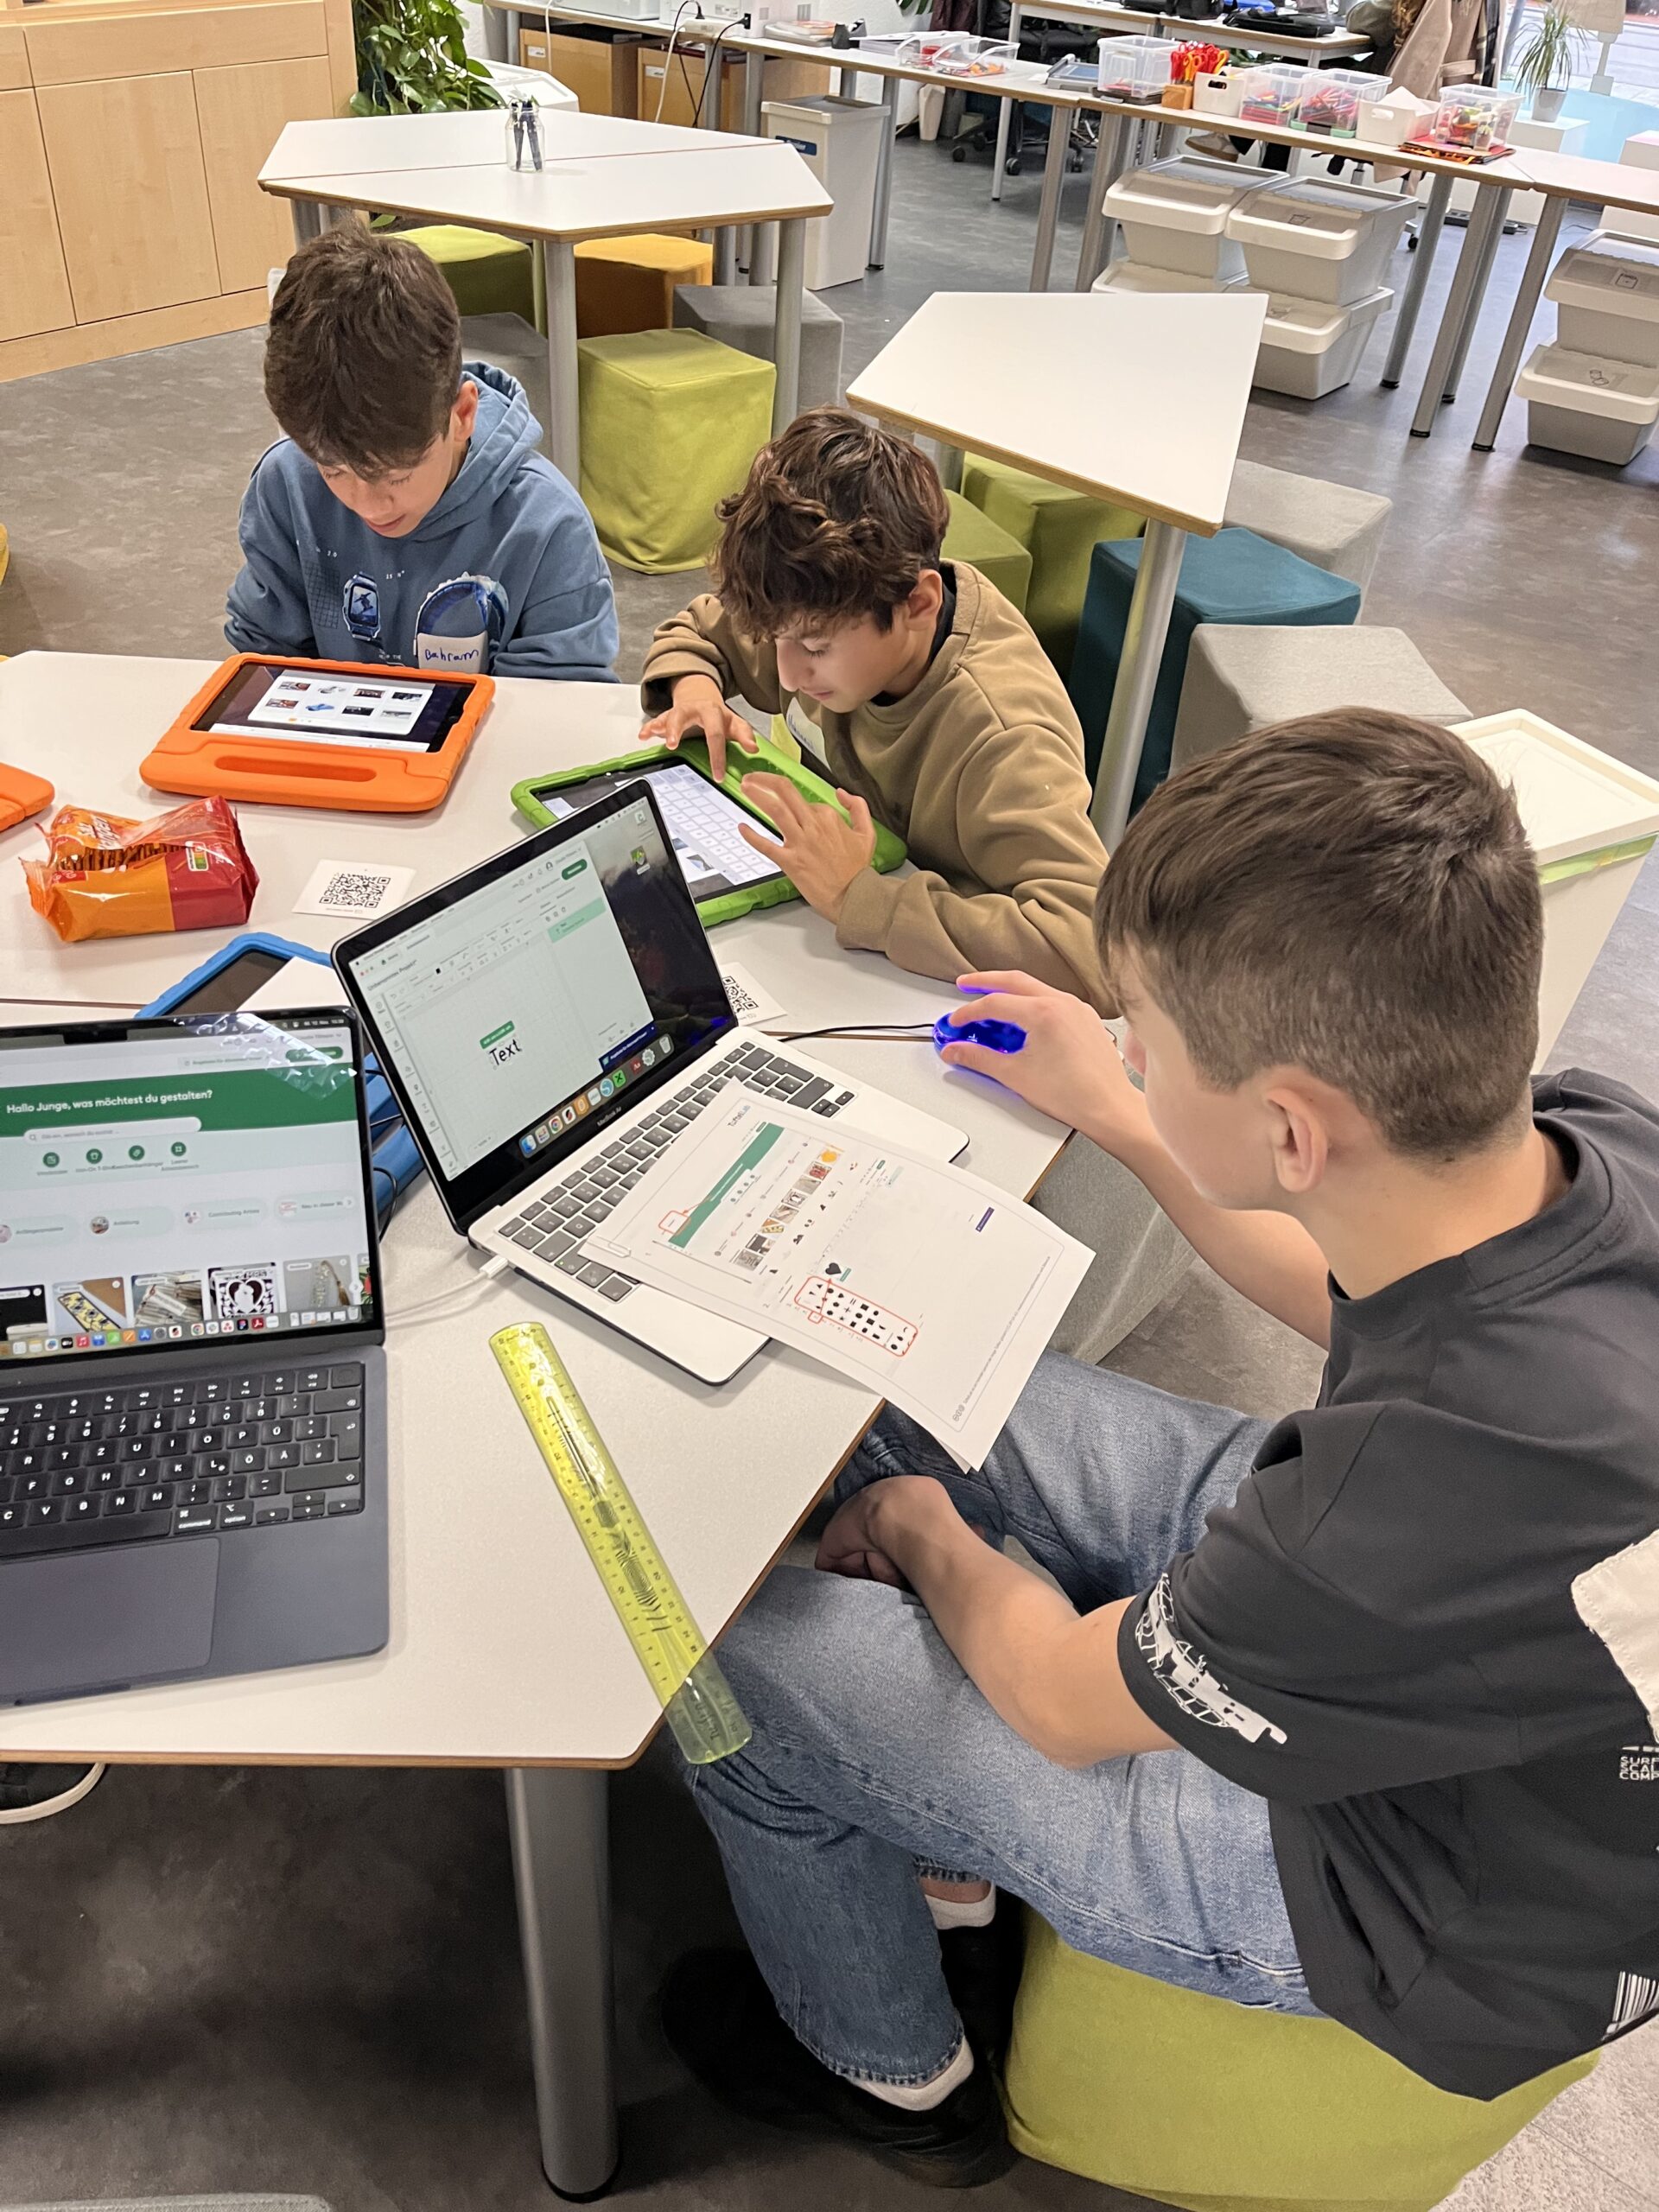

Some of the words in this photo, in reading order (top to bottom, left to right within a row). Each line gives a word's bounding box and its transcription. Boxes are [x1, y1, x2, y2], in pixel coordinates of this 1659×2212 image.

[489, 1039, 523, 1066] Text
[6, 1102, 35, 1114] Hallo
[36, 1101, 72, 1112] Junge,
[73, 1100, 93, 1109] was
[95, 1095, 143, 1107] möchtest
[145, 1093, 159, 1104] du
[160, 1090, 213, 1104] gestalten?
[97, 1447, 105, 1457] Z
[203, 1435, 212, 1444] O
[238, 1431, 246, 1440] P
[28, 1482, 36, 1491] F
[101, 1472, 111, 1481] H
[139, 1468, 146, 1478] J
[175, 1464, 182, 1472] K
[3, 1511, 13, 1520] C
[41, 1506, 51, 1516] V
[116, 1497, 125, 1506] N
[152, 1492, 162, 1502] M
[1619, 1771, 1659, 1781] COMP
